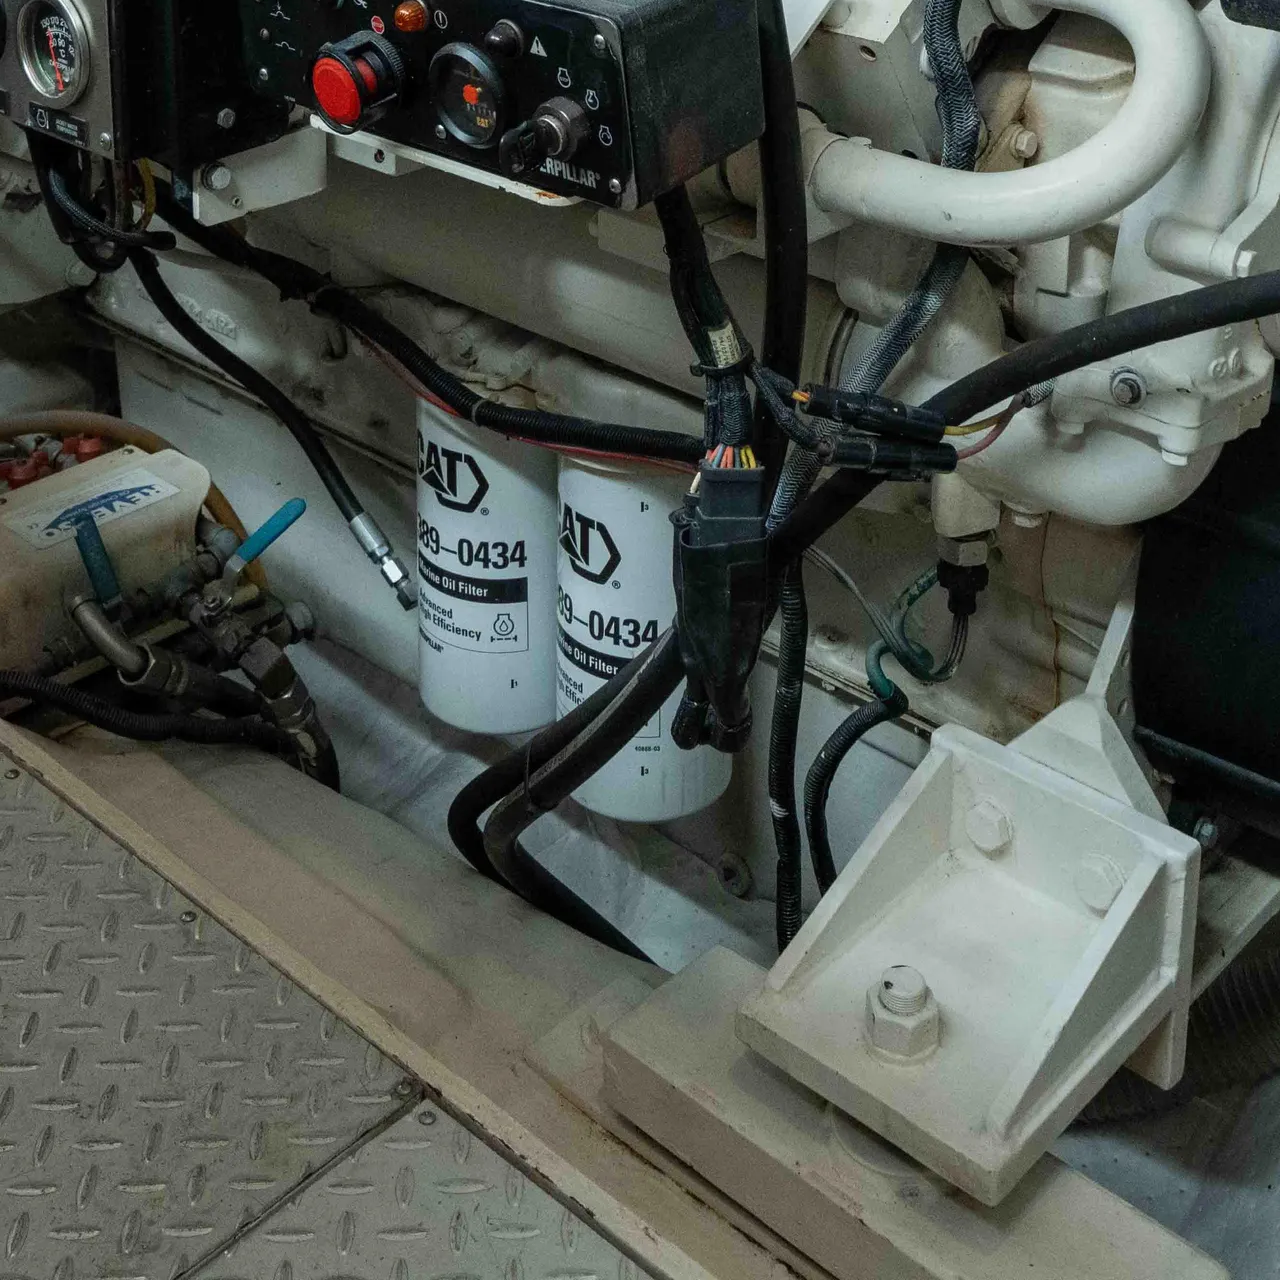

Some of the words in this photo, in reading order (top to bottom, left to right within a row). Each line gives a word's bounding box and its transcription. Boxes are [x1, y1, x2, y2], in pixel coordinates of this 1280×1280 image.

[558, 500, 596, 566] AT
[442, 576, 455, 591] Oil
[458, 581, 488, 597] Filter
[432, 613, 482, 642] Efficiency
[574, 647, 586, 665] Oil
[589, 657, 618, 675] Filter
